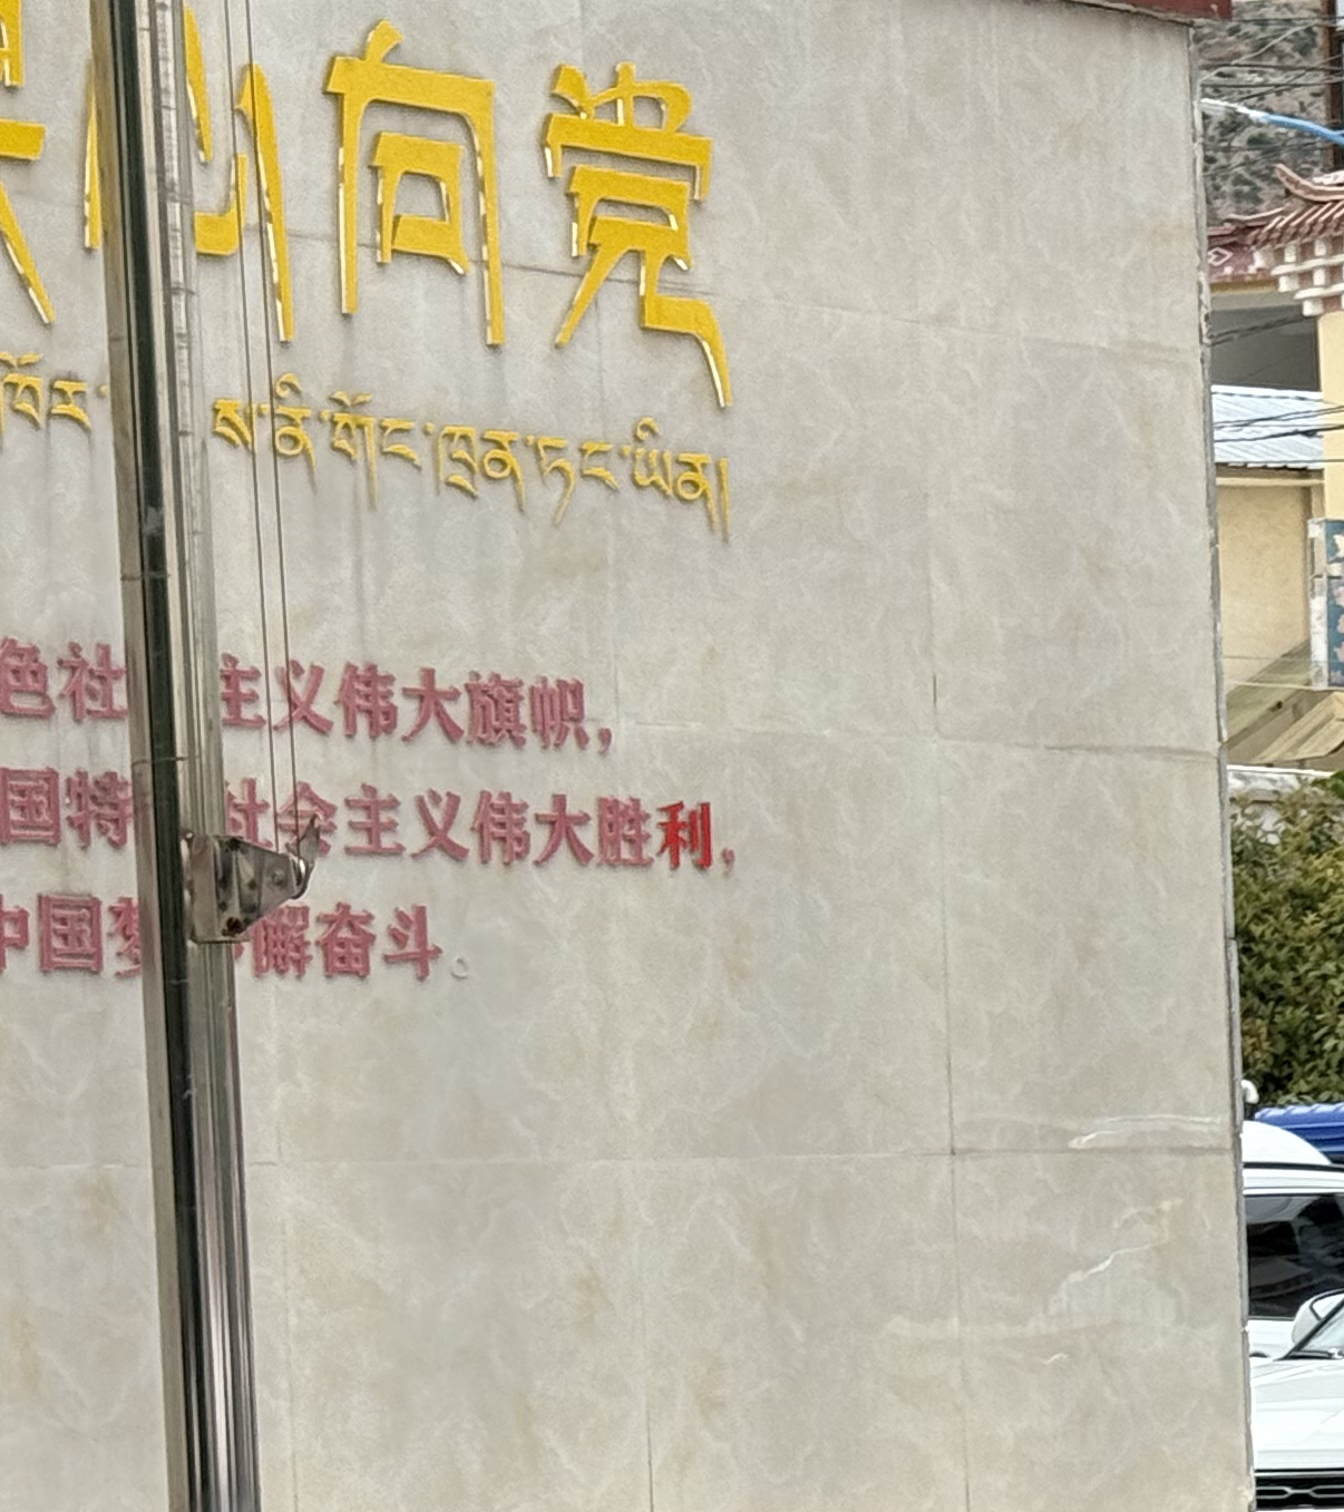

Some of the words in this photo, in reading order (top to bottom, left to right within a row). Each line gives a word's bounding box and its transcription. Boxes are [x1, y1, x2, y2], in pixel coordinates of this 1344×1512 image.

[0, 637, 612, 754] 色社主义伟大旗帜，
[0, 767, 735, 879] 国特社会主义伟大胜利，
[0, 893, 469, 981] 国梦懈奋斗。
